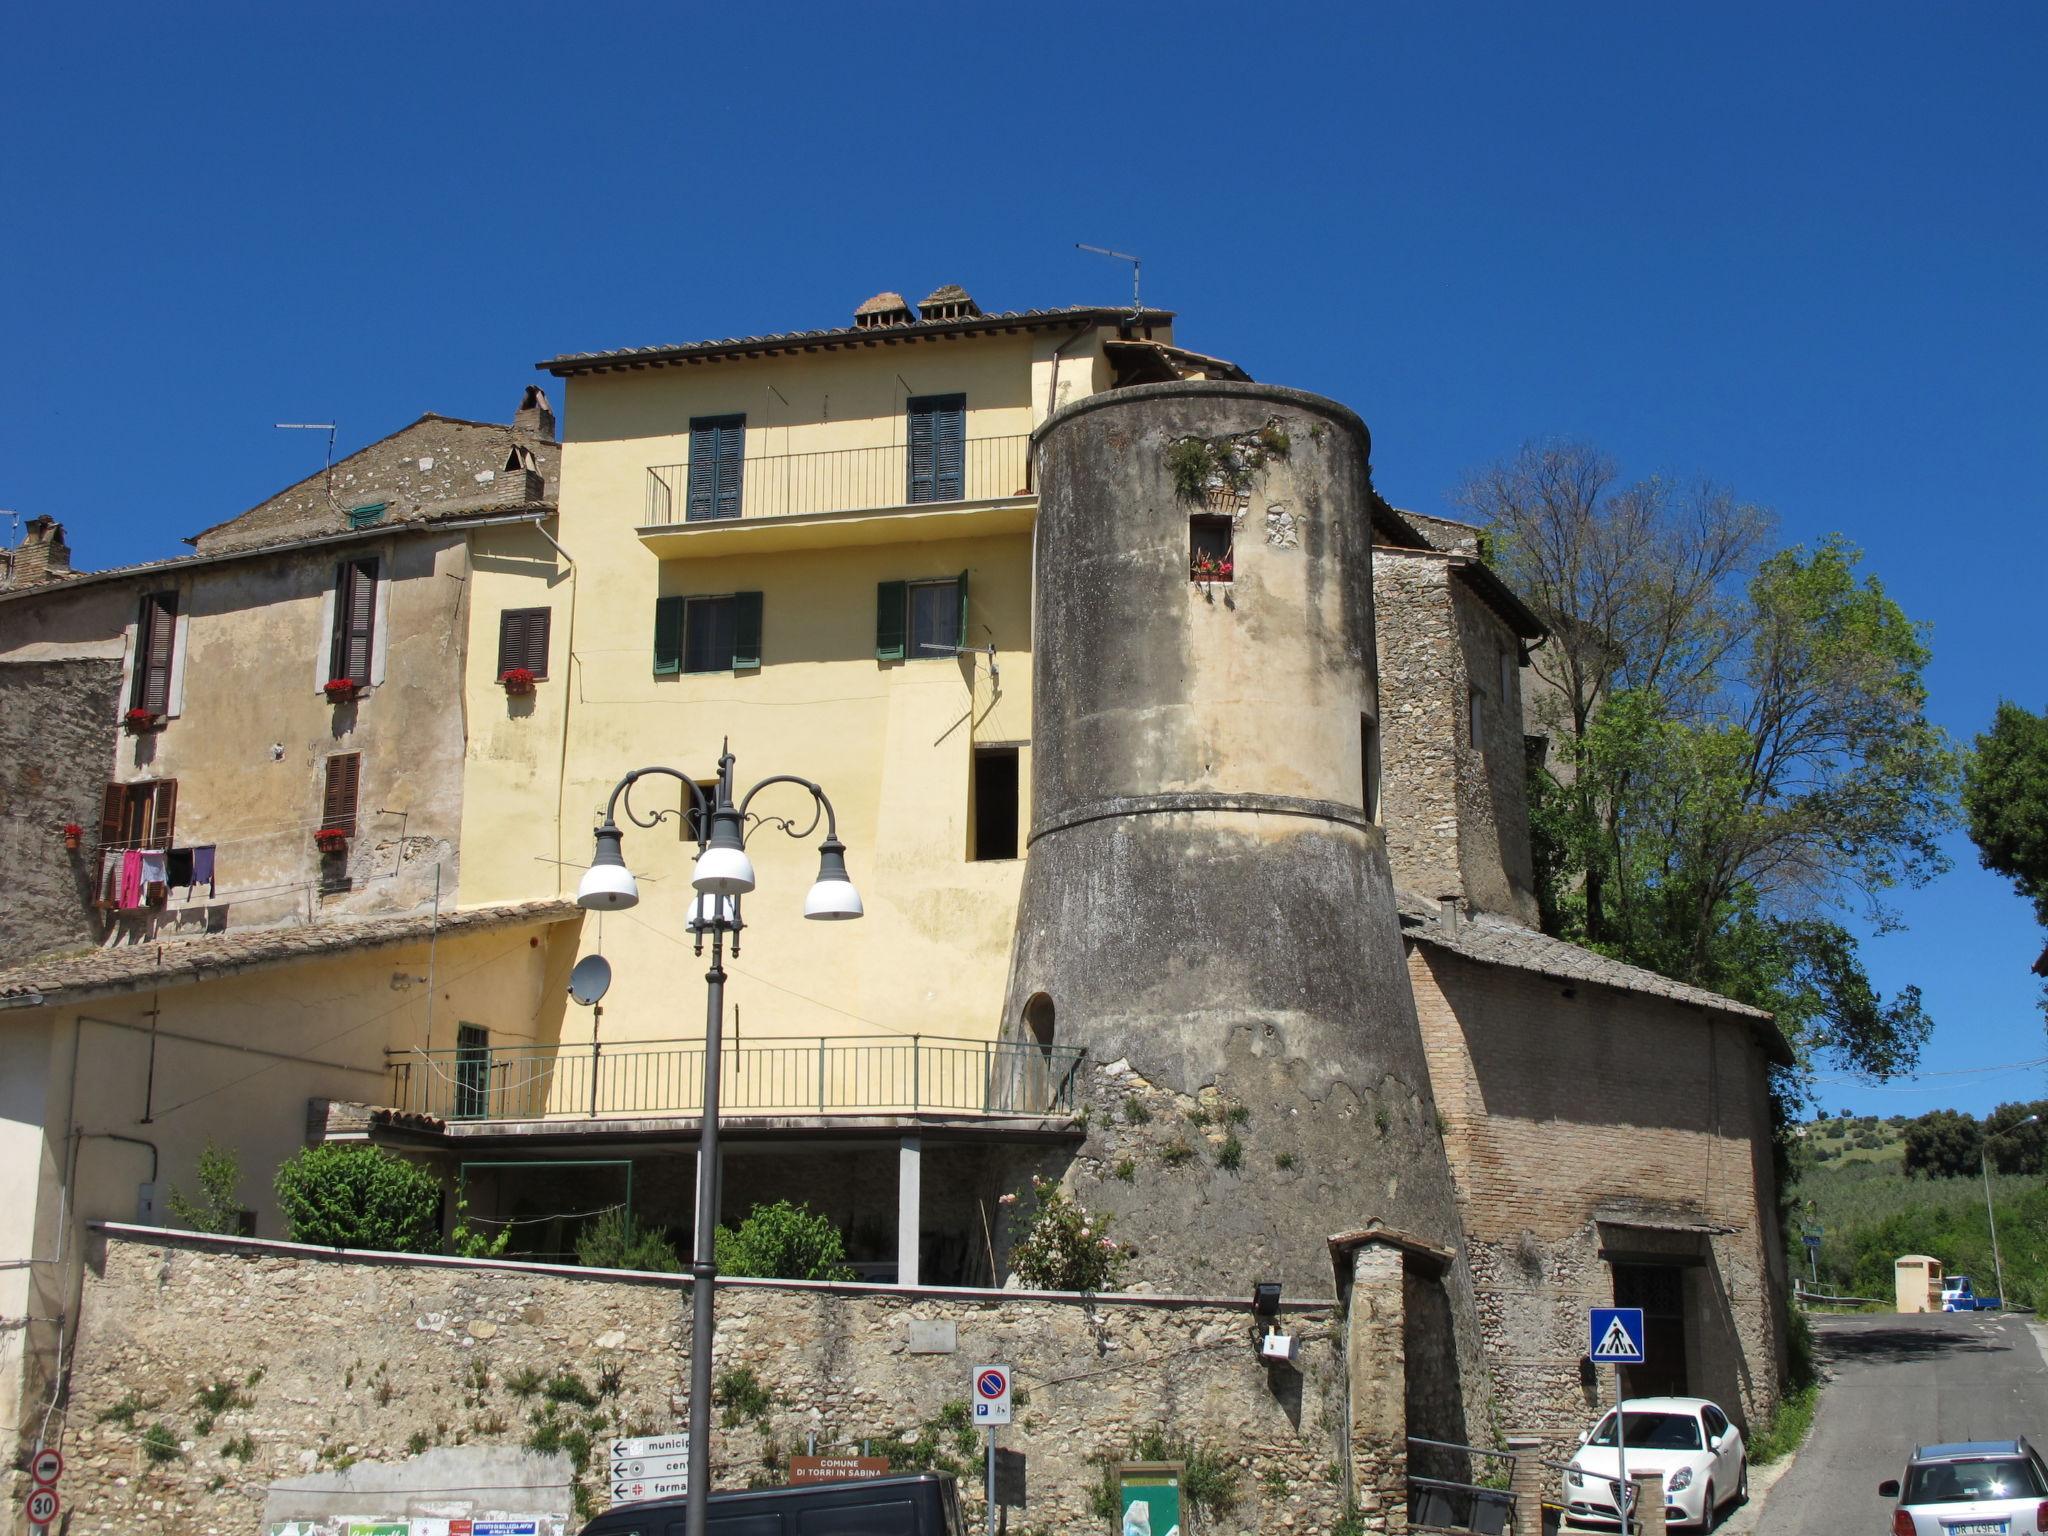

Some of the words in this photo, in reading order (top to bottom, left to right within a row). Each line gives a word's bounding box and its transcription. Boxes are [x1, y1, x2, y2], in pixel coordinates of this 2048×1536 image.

[978, 1405, 986, 1414] P
[648, 1438, 690, 1450] municip
[666, 1461, 688, 1470] cen
[848, 1469, 881, 1478] SABINA
[654, 1483, 687, 1492] farma
[34, 1497, 53, 1515] 30
